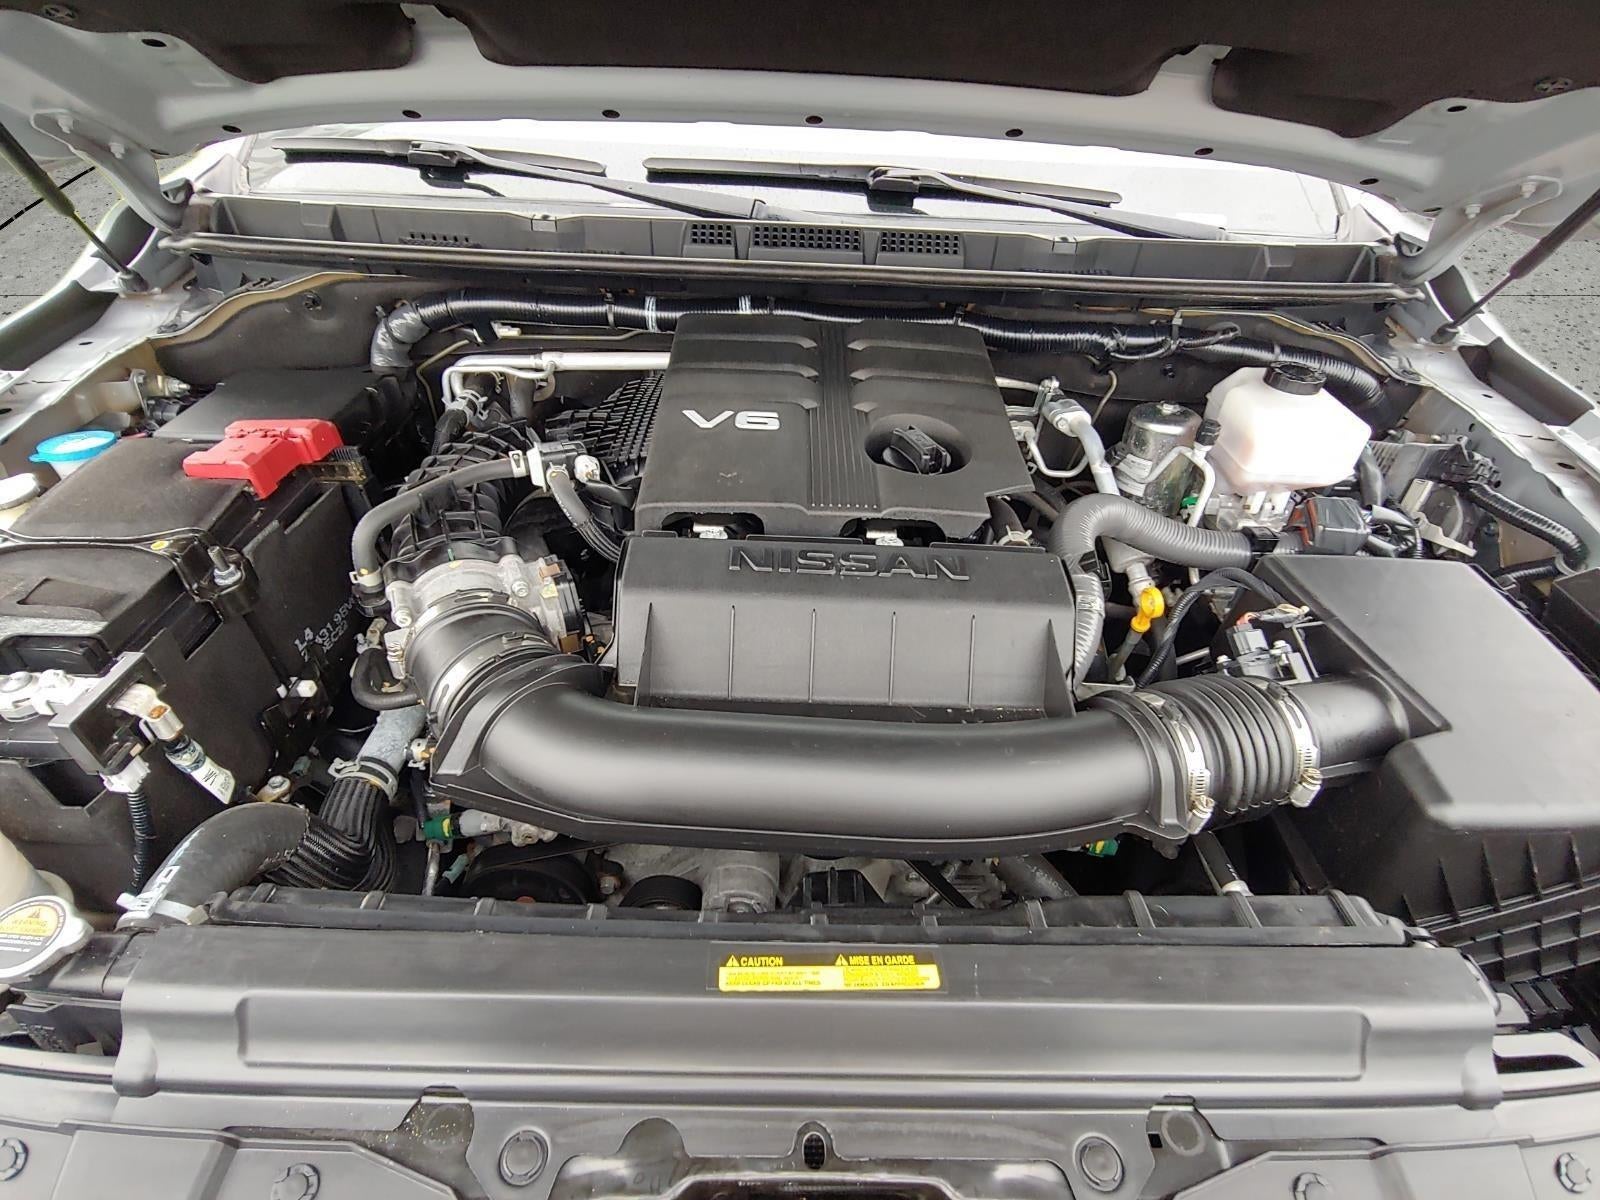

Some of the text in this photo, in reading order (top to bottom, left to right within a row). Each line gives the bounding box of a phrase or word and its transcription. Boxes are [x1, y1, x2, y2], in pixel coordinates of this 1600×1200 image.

[682, 410, 780, 430] V6
[729, 546, 970, 580] NISSAN
[740, 956, 783, 967] CAUTION
[849, 955, 915, 966] MISE EN GARDE
